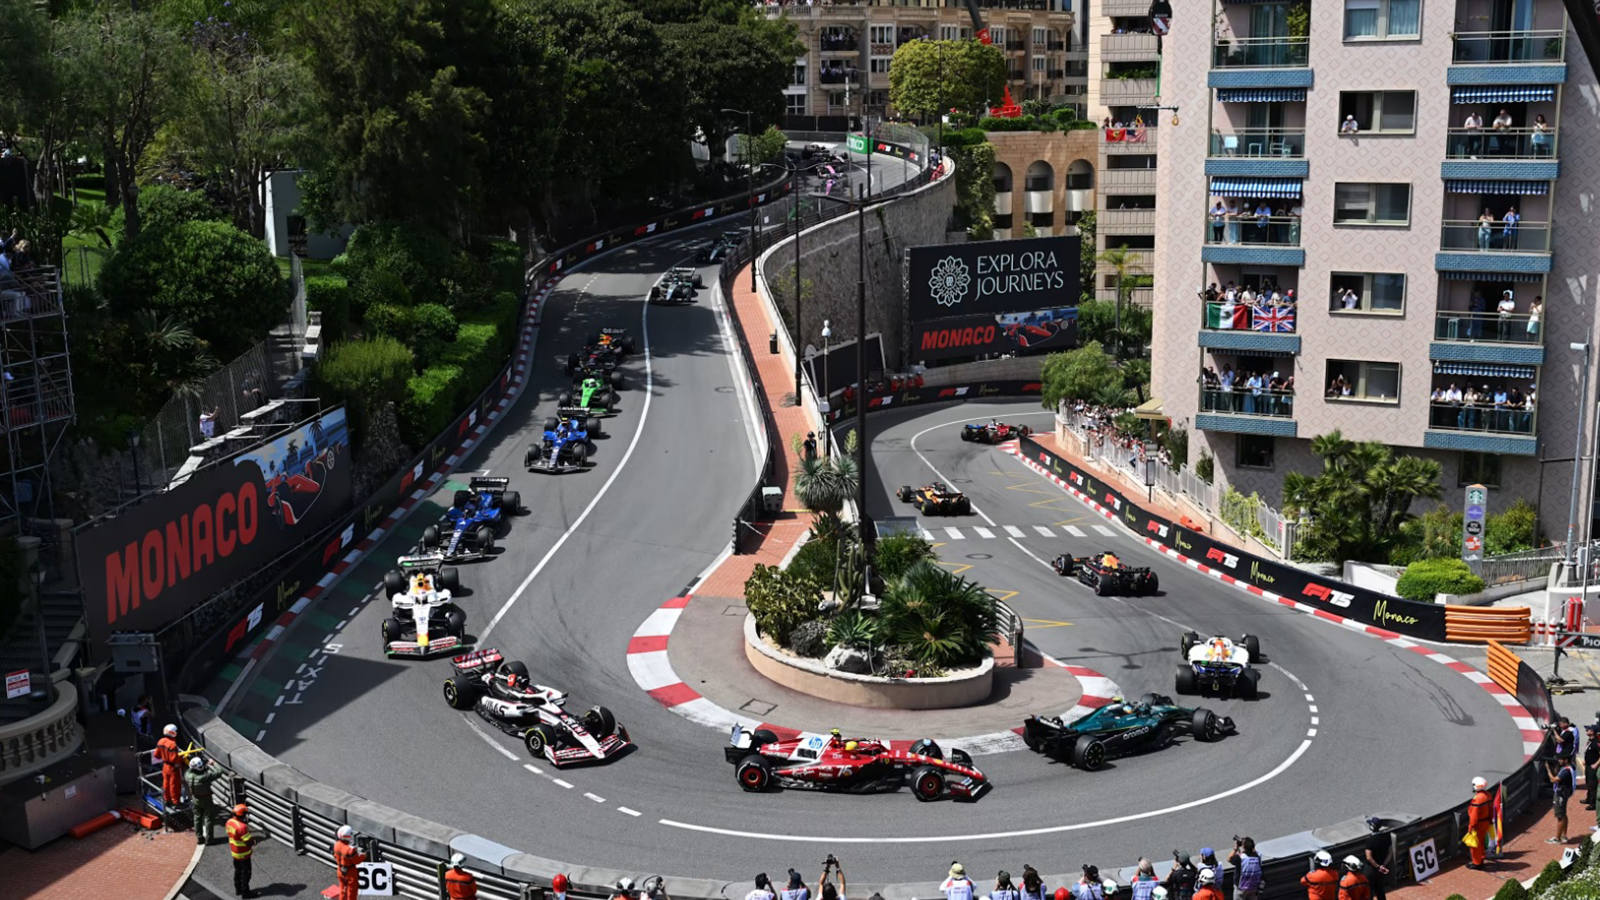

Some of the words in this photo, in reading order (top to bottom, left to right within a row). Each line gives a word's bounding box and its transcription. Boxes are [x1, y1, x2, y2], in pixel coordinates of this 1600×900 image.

[977, 251, 1058, 275] EXPLORA
[974, 270, 1064, 301] JOURNEYS
[921, 325, 996, 350] MONACO
[105, 481, 258, 626] MONACO
[1250, 561, 1276, 586] Monaco
[1373, 599, 1419, 627] Monaco
[1122, 726, 1150, 741] aramco
[1414, 845, 1435, 874] SC
[357, 867, 388, 891] SC
